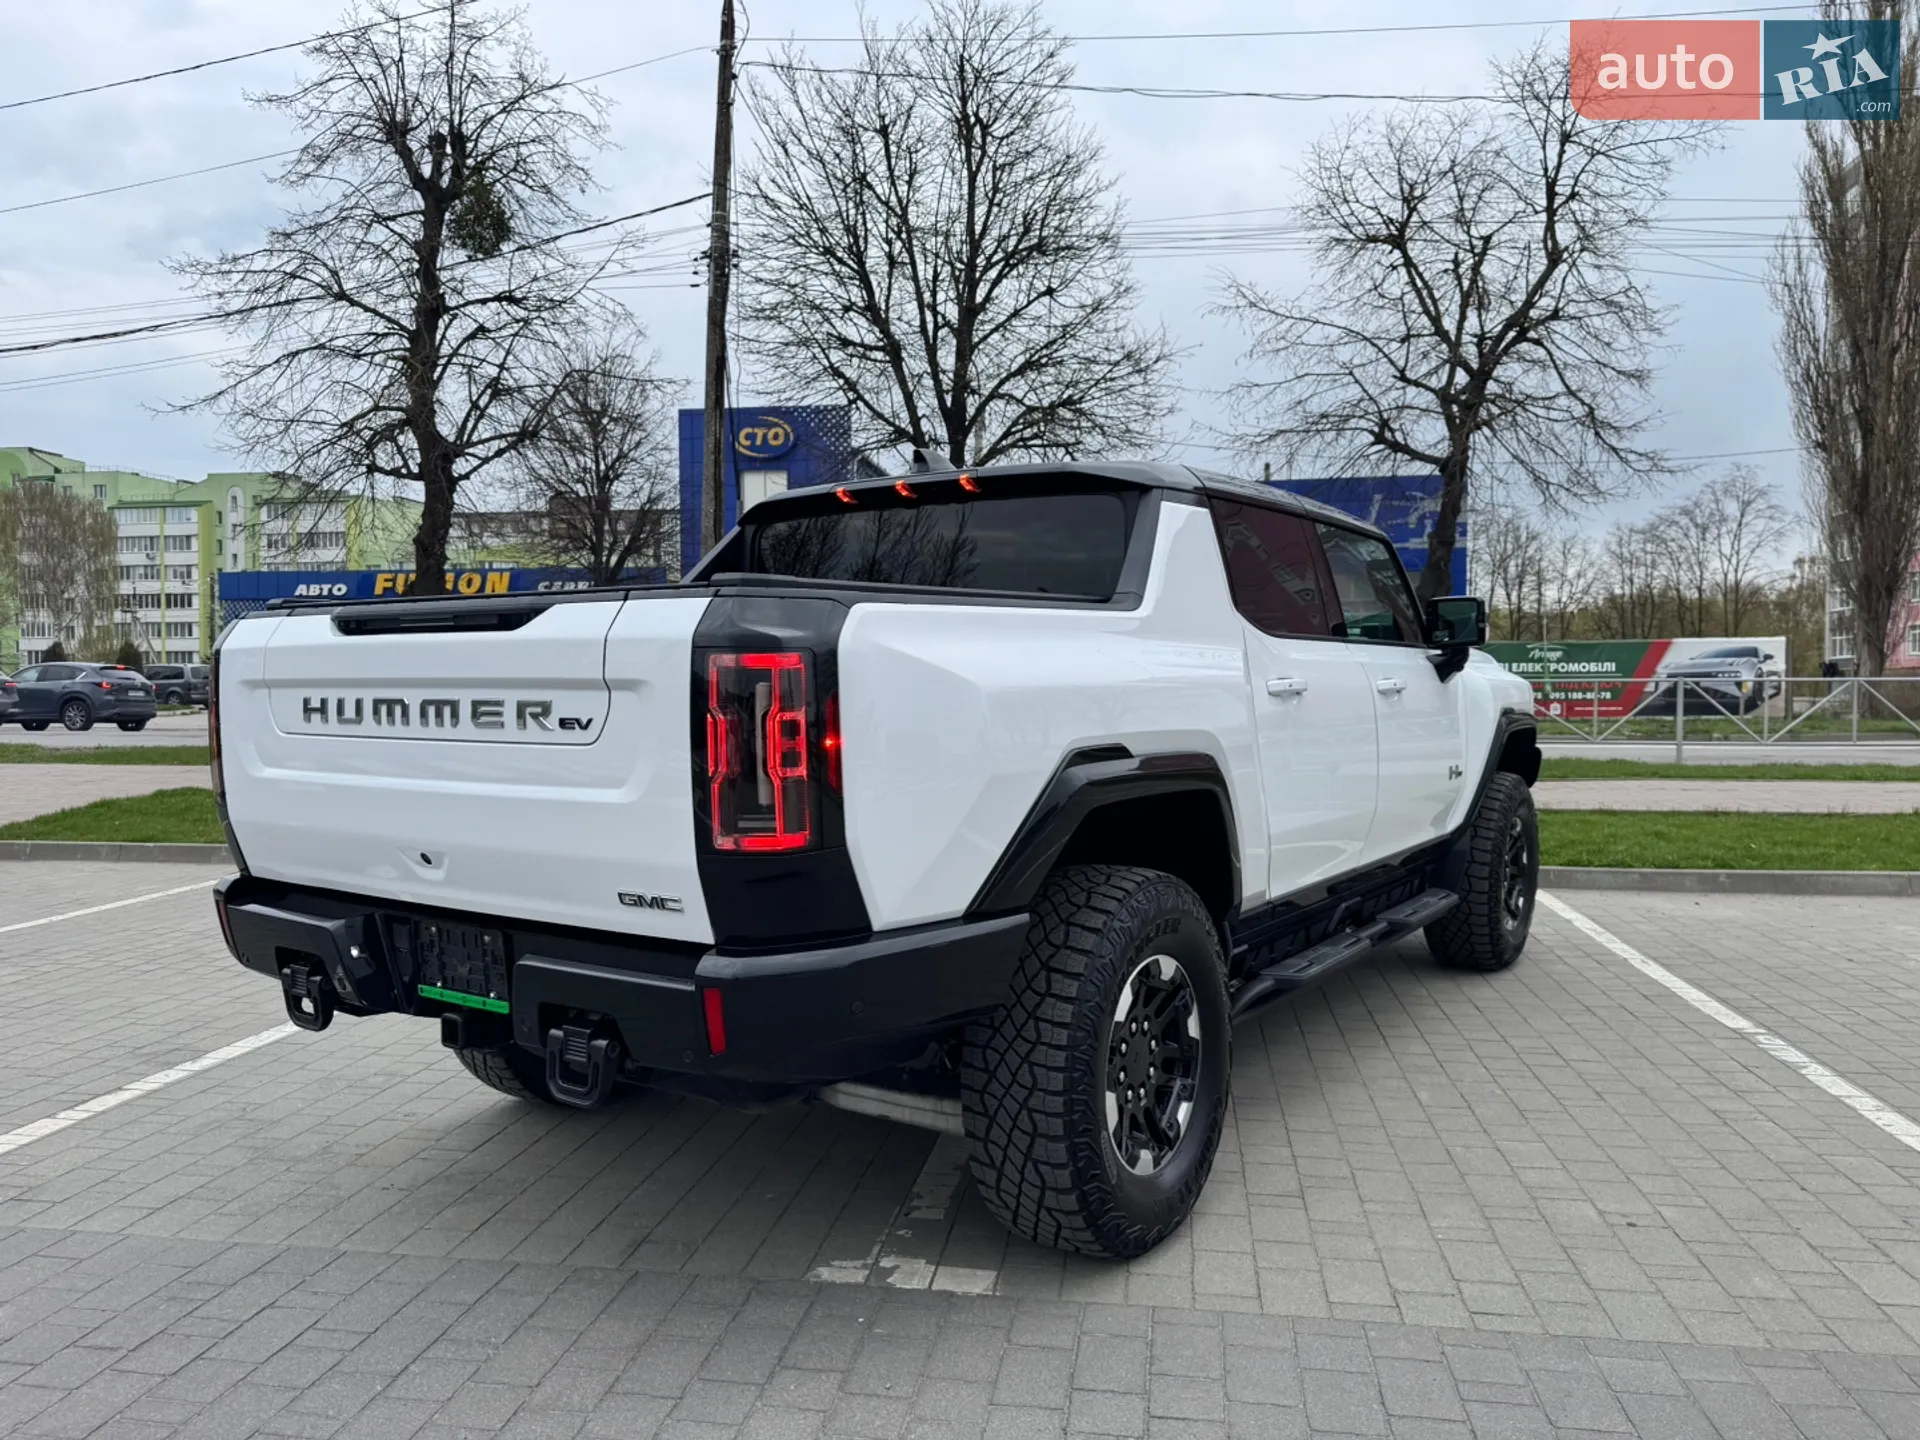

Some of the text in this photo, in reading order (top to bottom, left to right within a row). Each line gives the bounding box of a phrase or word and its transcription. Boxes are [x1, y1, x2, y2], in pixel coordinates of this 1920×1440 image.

[738, 427, 786, 447] СТО
[294, 583, 348, 597] АВТО
[374, 571, 511, 595] FUION
[302, 696, 594, 731] HUMMER EV
[617, 890, 685, 913] GMC
